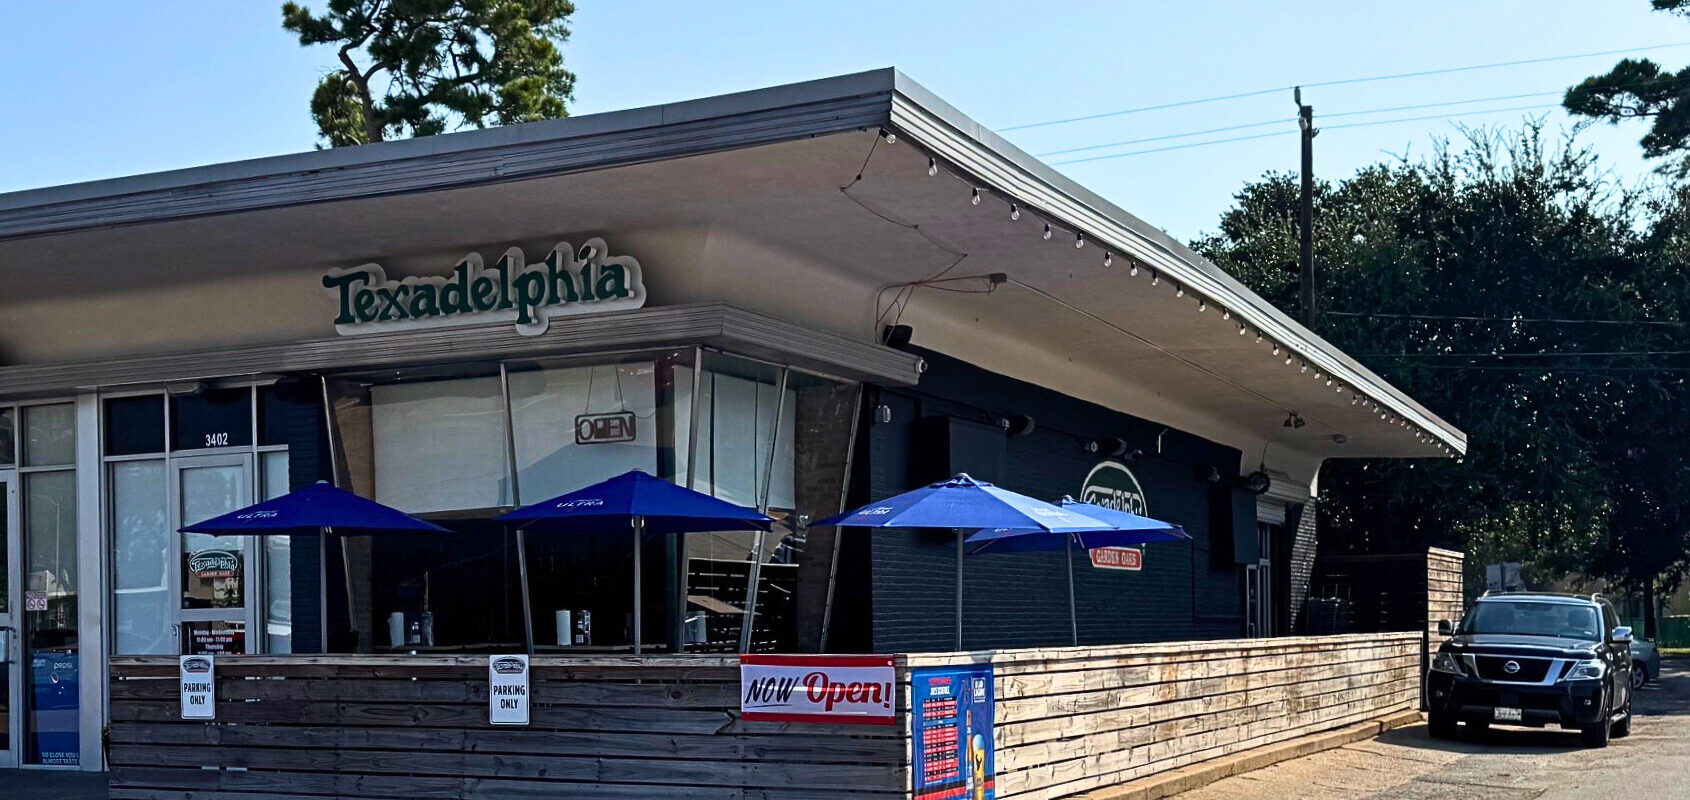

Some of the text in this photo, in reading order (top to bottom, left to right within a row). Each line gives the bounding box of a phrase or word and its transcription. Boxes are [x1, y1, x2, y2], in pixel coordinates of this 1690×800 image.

[322, 245, 633, 325] Texadelphia
[578, 415, 634, 440] OPEN
[205, 432, 228, 446] 3402
[192, 557, 236, 571] Texadelphia
[1096, 549, 1136, 566] GARDEN OAKS
[183, 682, 211, 693] PARKING
[493, 685, 525, 696] PARKING
[745, 671, 892, 712] NOW Open!
[190, 695, 206, 705] ONLY
[500, 698, 519, 709] ONLY
